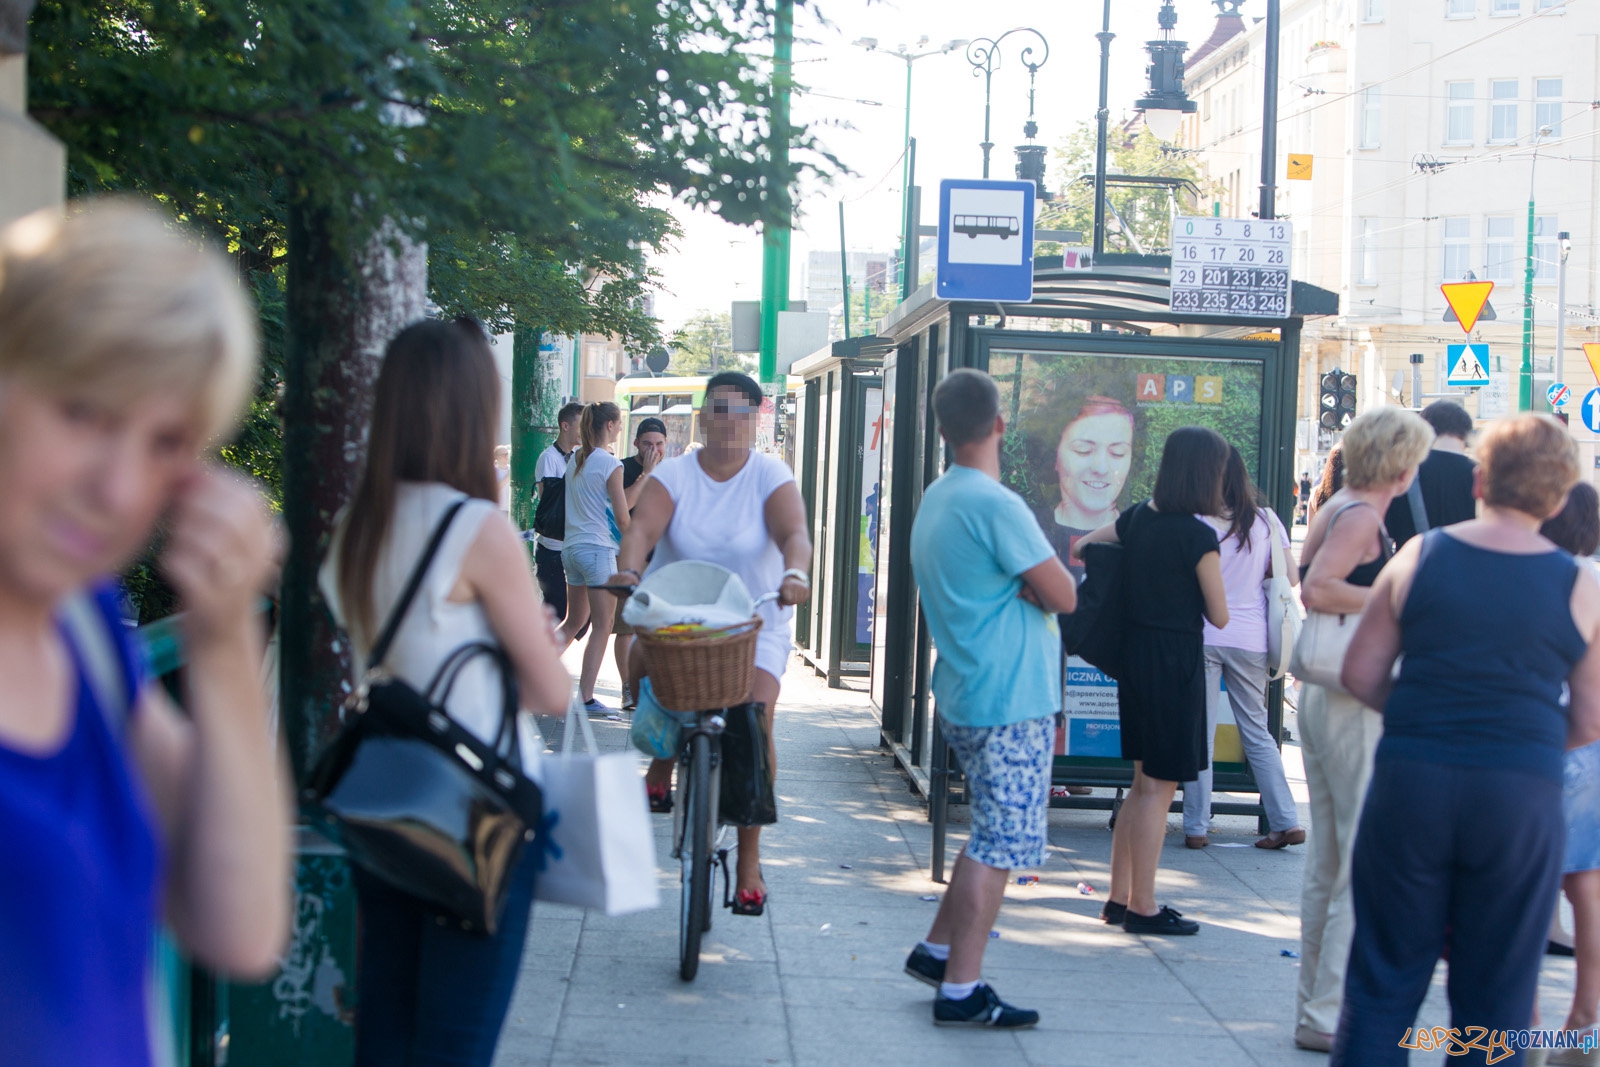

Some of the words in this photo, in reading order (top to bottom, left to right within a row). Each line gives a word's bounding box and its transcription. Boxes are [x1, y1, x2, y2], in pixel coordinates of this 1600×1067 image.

[1186, 222, 1194, 235] 0
[1215, 223, 1222, 236] 5
[1244, 224, 1251, 237] 8
[1270, 226, 1284, 239] 13
[1182, 246, 1197, 259] 16
[1211, 247, 1226, 260] 17
[1239, 248, 1254, 261] 20
[1268, 250, 1283, 263] 28
[1180, 270, 1195, 283] 29
[1204, 270, 1228, 284] 201
[1232, 271, 1256, 286] 231
[1261, 273, 1286, 287] 232
[1174, 292, 1199, 307] 233
[1203, 293, 1228, 308] 235
[1231, 294, 1256, 309] 243
[1259, 296, 1284, 310] 248
[1066, 671, 1102, 682] ICZNA
